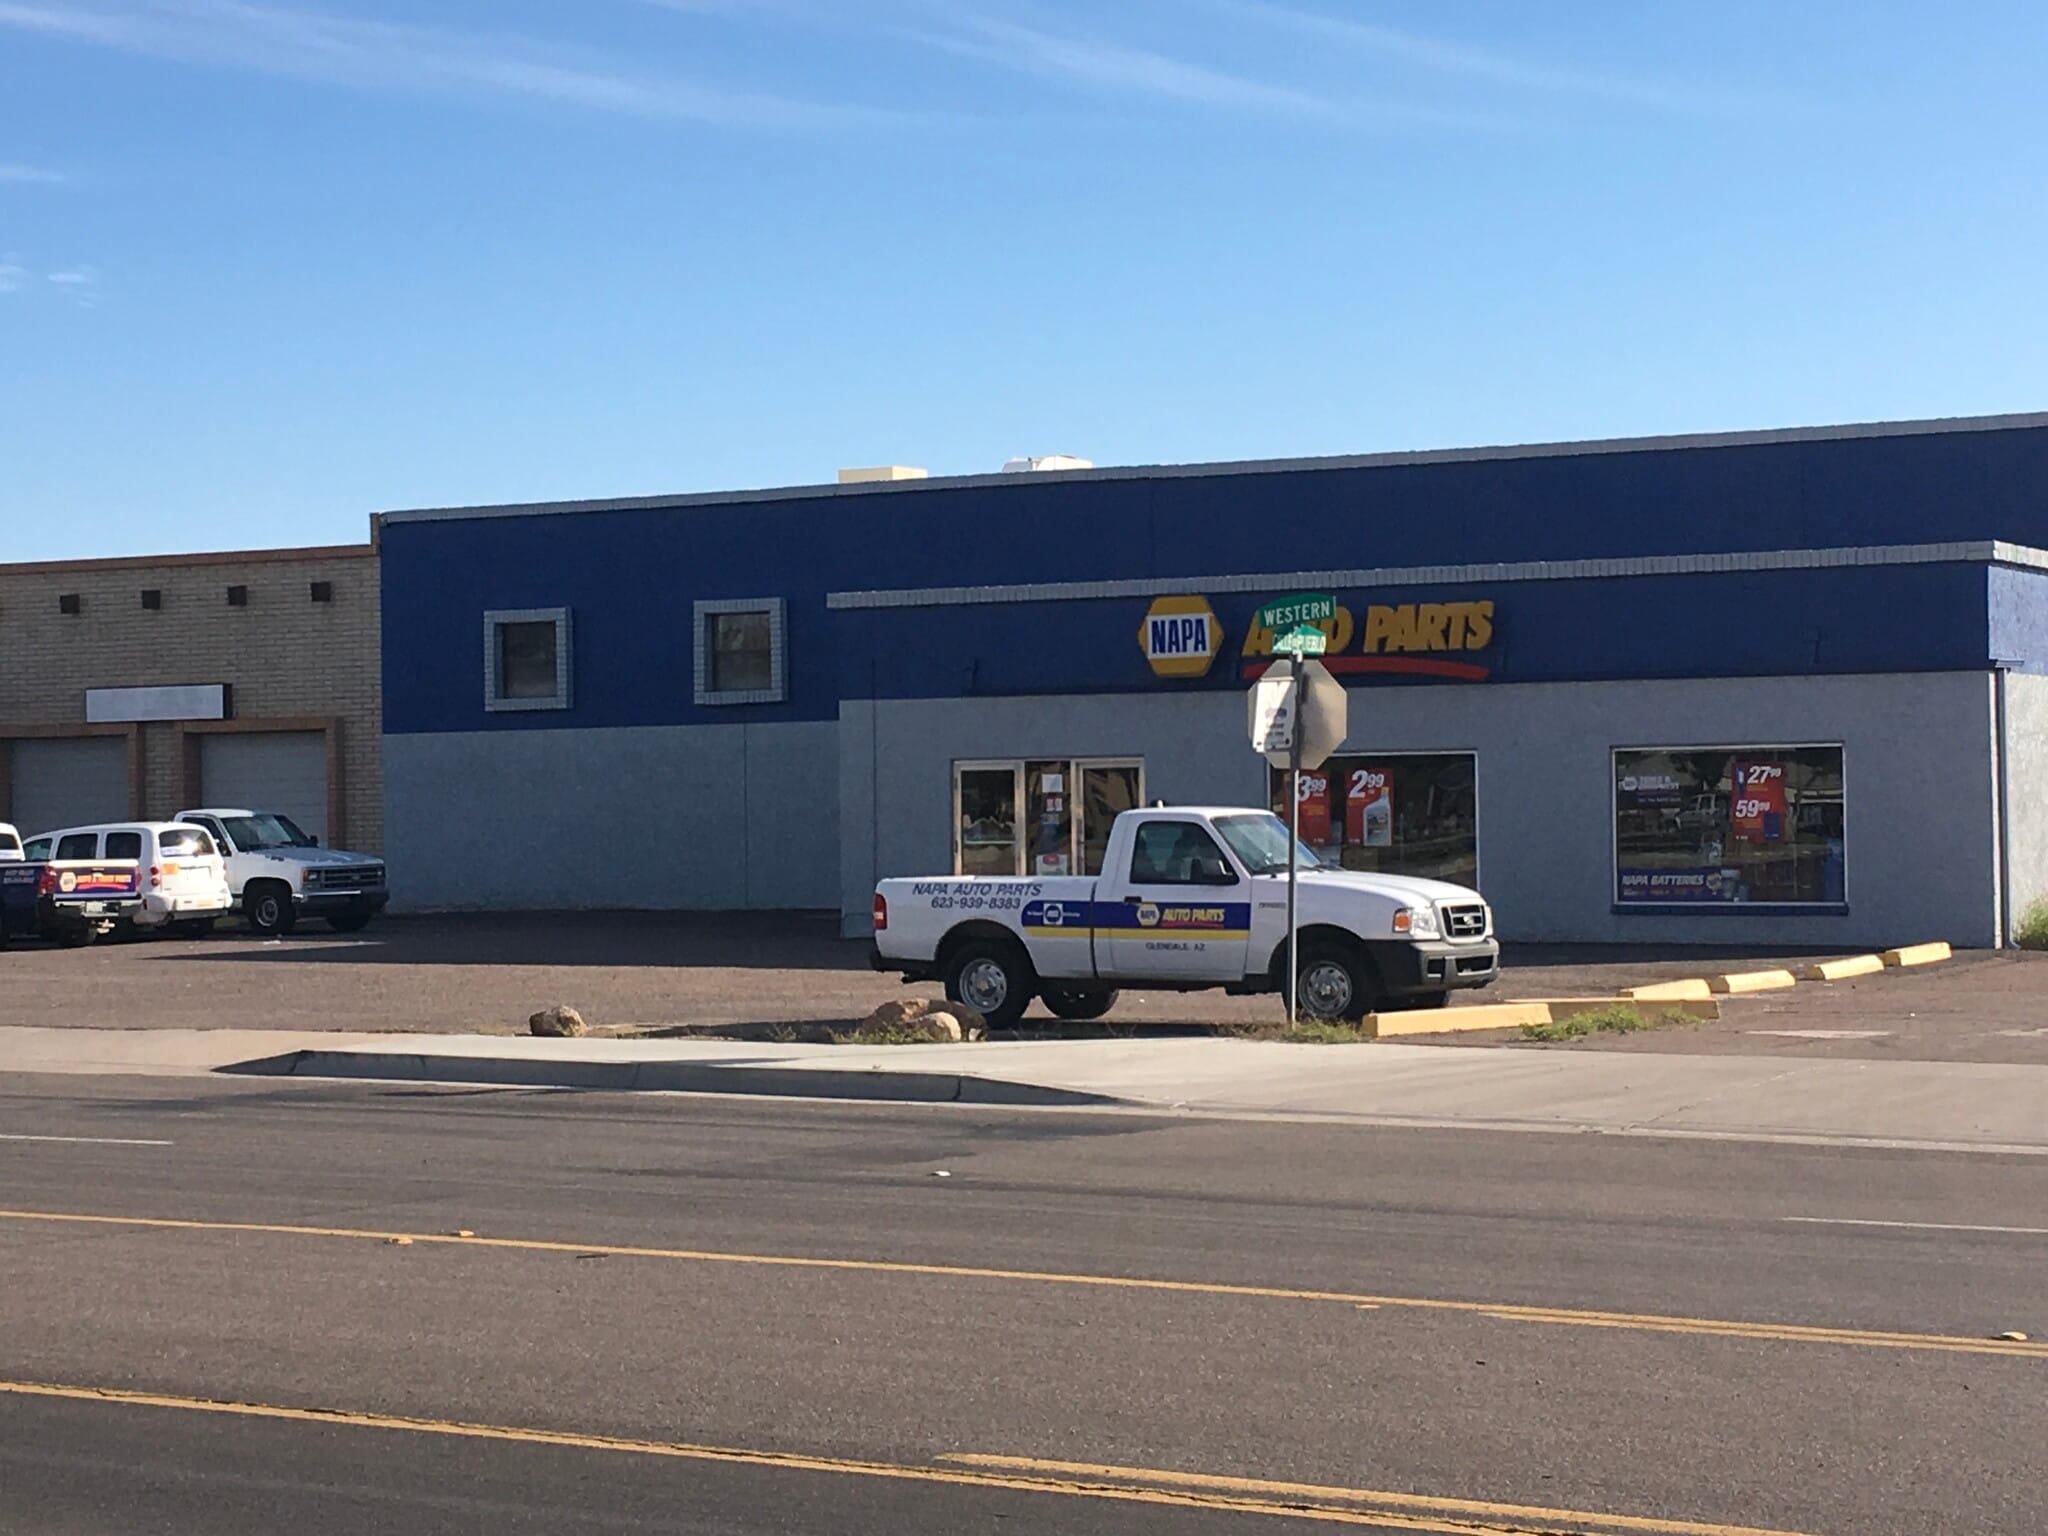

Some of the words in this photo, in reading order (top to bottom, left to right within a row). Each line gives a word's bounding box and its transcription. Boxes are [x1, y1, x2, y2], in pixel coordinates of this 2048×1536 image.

[1263, 600, 1331, 627] WESTERN
[1363, 600, 1495, 653] PARTS
[1151, 616, 1207, 654] NAPA
[1622, 875, 1649, 886] NAPA
[1650, 874, 1705, 886] BATTERIES
[912, 883, 948, 895] NAPA
[953, 883, 992, 895] AUTO
[995, 883, 1043, 895] PARTS
[930, 896, 1022, 910] 623-939-8383
[1162, 908, 1191, 922] AUTO
[1192, 908, 1226, 922] PARTS
[1194, 943, 1206, 951] AZ
